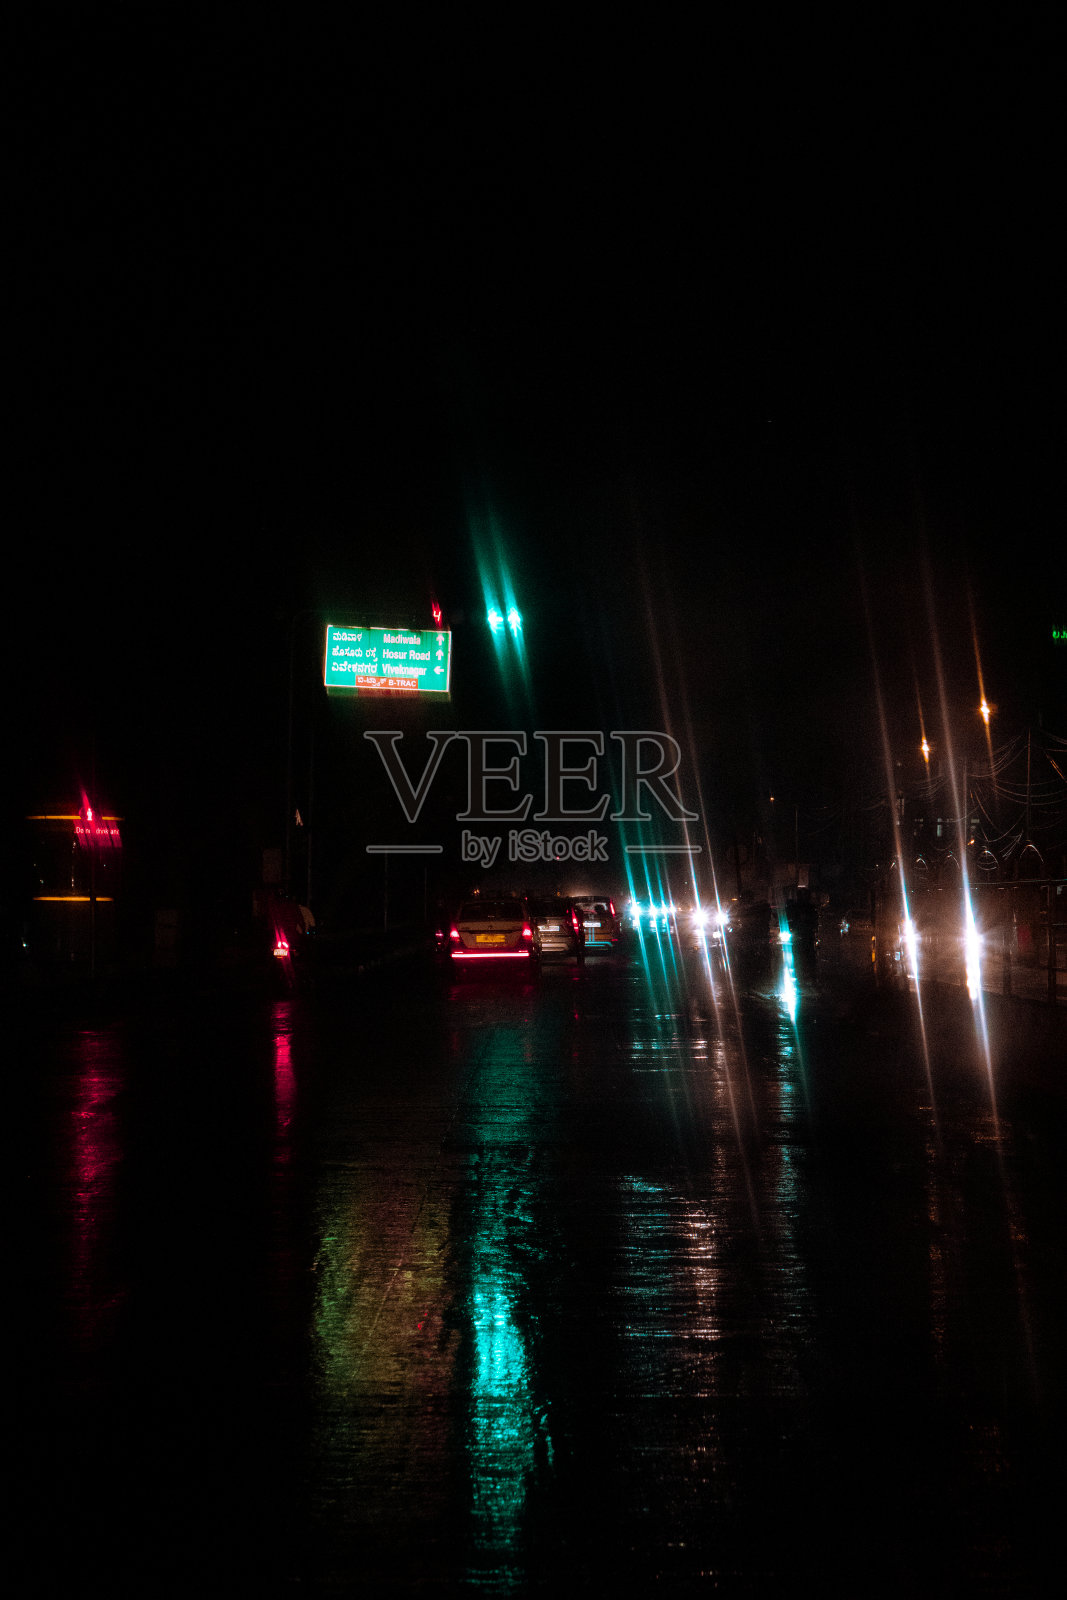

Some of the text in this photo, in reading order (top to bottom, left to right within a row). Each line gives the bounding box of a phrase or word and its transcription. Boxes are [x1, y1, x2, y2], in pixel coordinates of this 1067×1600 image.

[383, 633, 421, 645] Madiwala
[382, 648, 431, 661] Hosur Road
[381, 663, 427, 678] Viveknagar
[388, 679, 417, 687] B-TRAC
